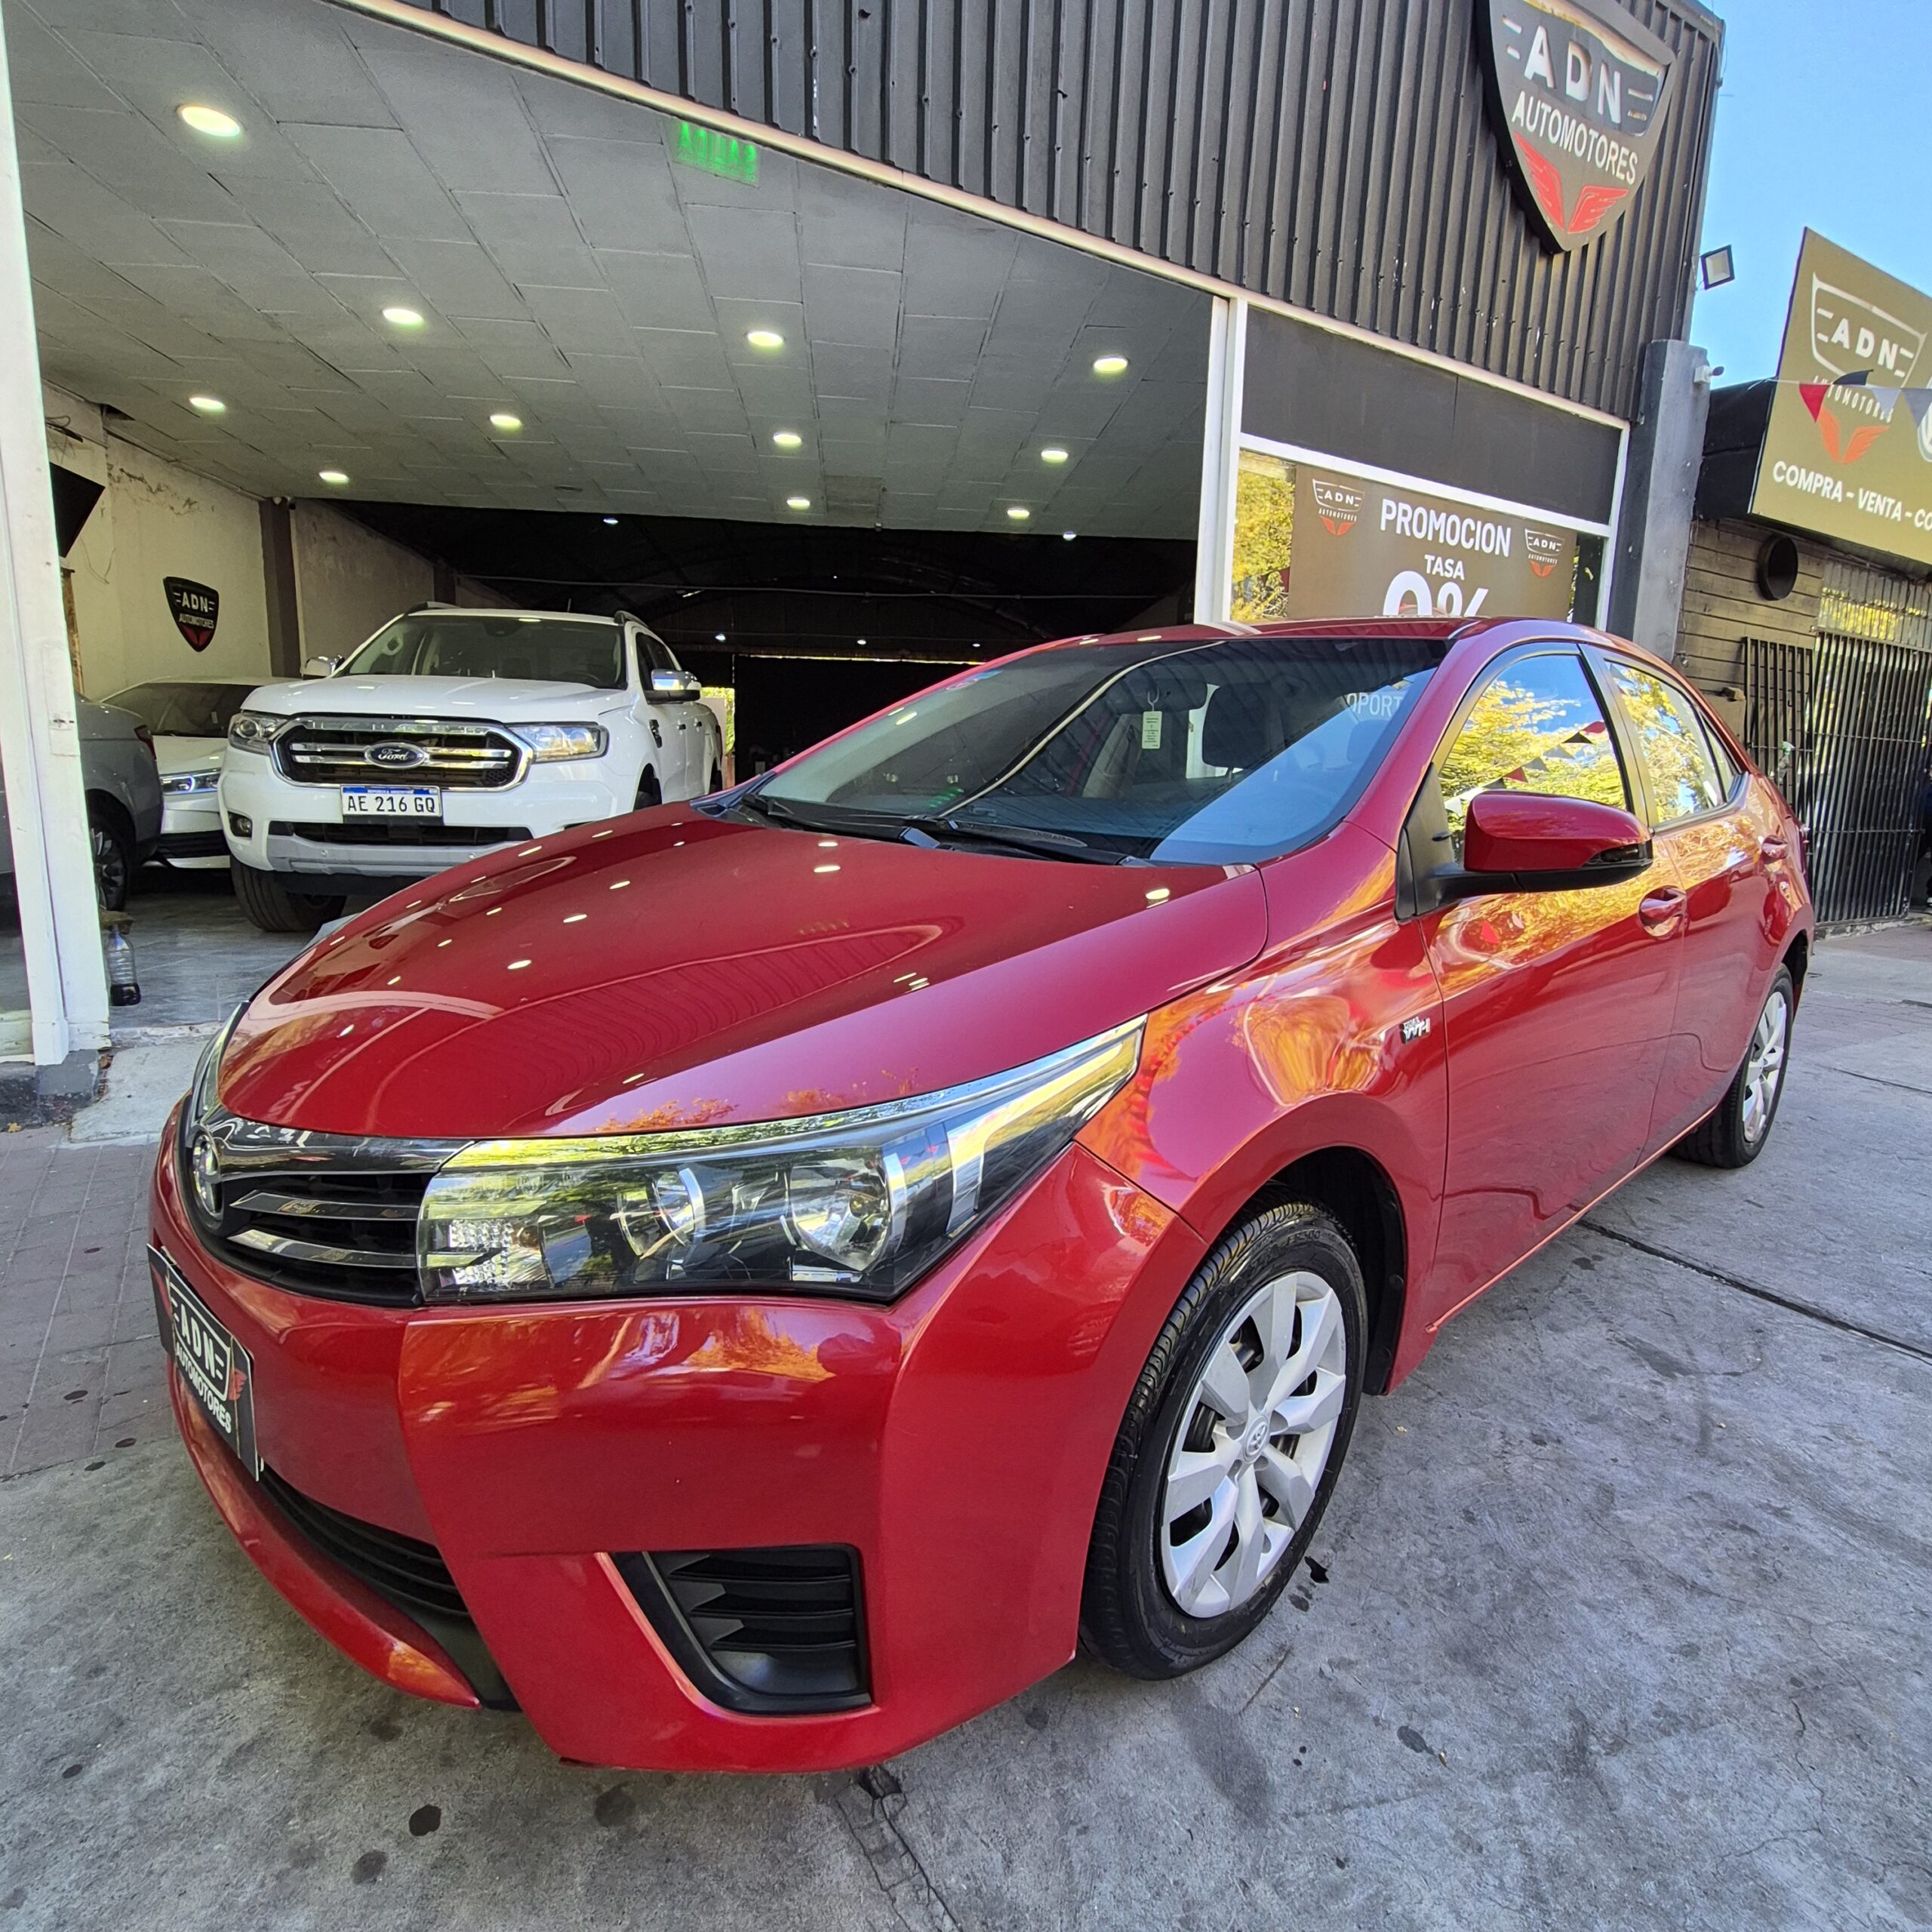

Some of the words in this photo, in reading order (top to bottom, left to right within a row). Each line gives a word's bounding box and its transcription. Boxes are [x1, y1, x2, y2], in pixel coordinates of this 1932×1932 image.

[1524, 25, 1621, 124] ADN
[1512, 90, 1638, 185] AUTOMOTORES
[1831, 318, 1898, 370] ADN
[1324, 490, 1355, 506] ADN
[1773, 460, 1844, 503] COMPRA
[1858, 488, 1903, 521] VENTA
[1380, 498, 1512, 557] PROMOCION
[1533, 537, 1556, 550] ADN
[1424, 554, 1465, 580] TASA
[182, 591, 208, 613] ADN
[377, 748, 409, 761] Ford
[347, 795, 369, 812] AE
[374, 796, 408, 813] 216
[180, 1303, 216, 1379] ADN
[176, 1341, 232, 1434] AUTOMOTORES
